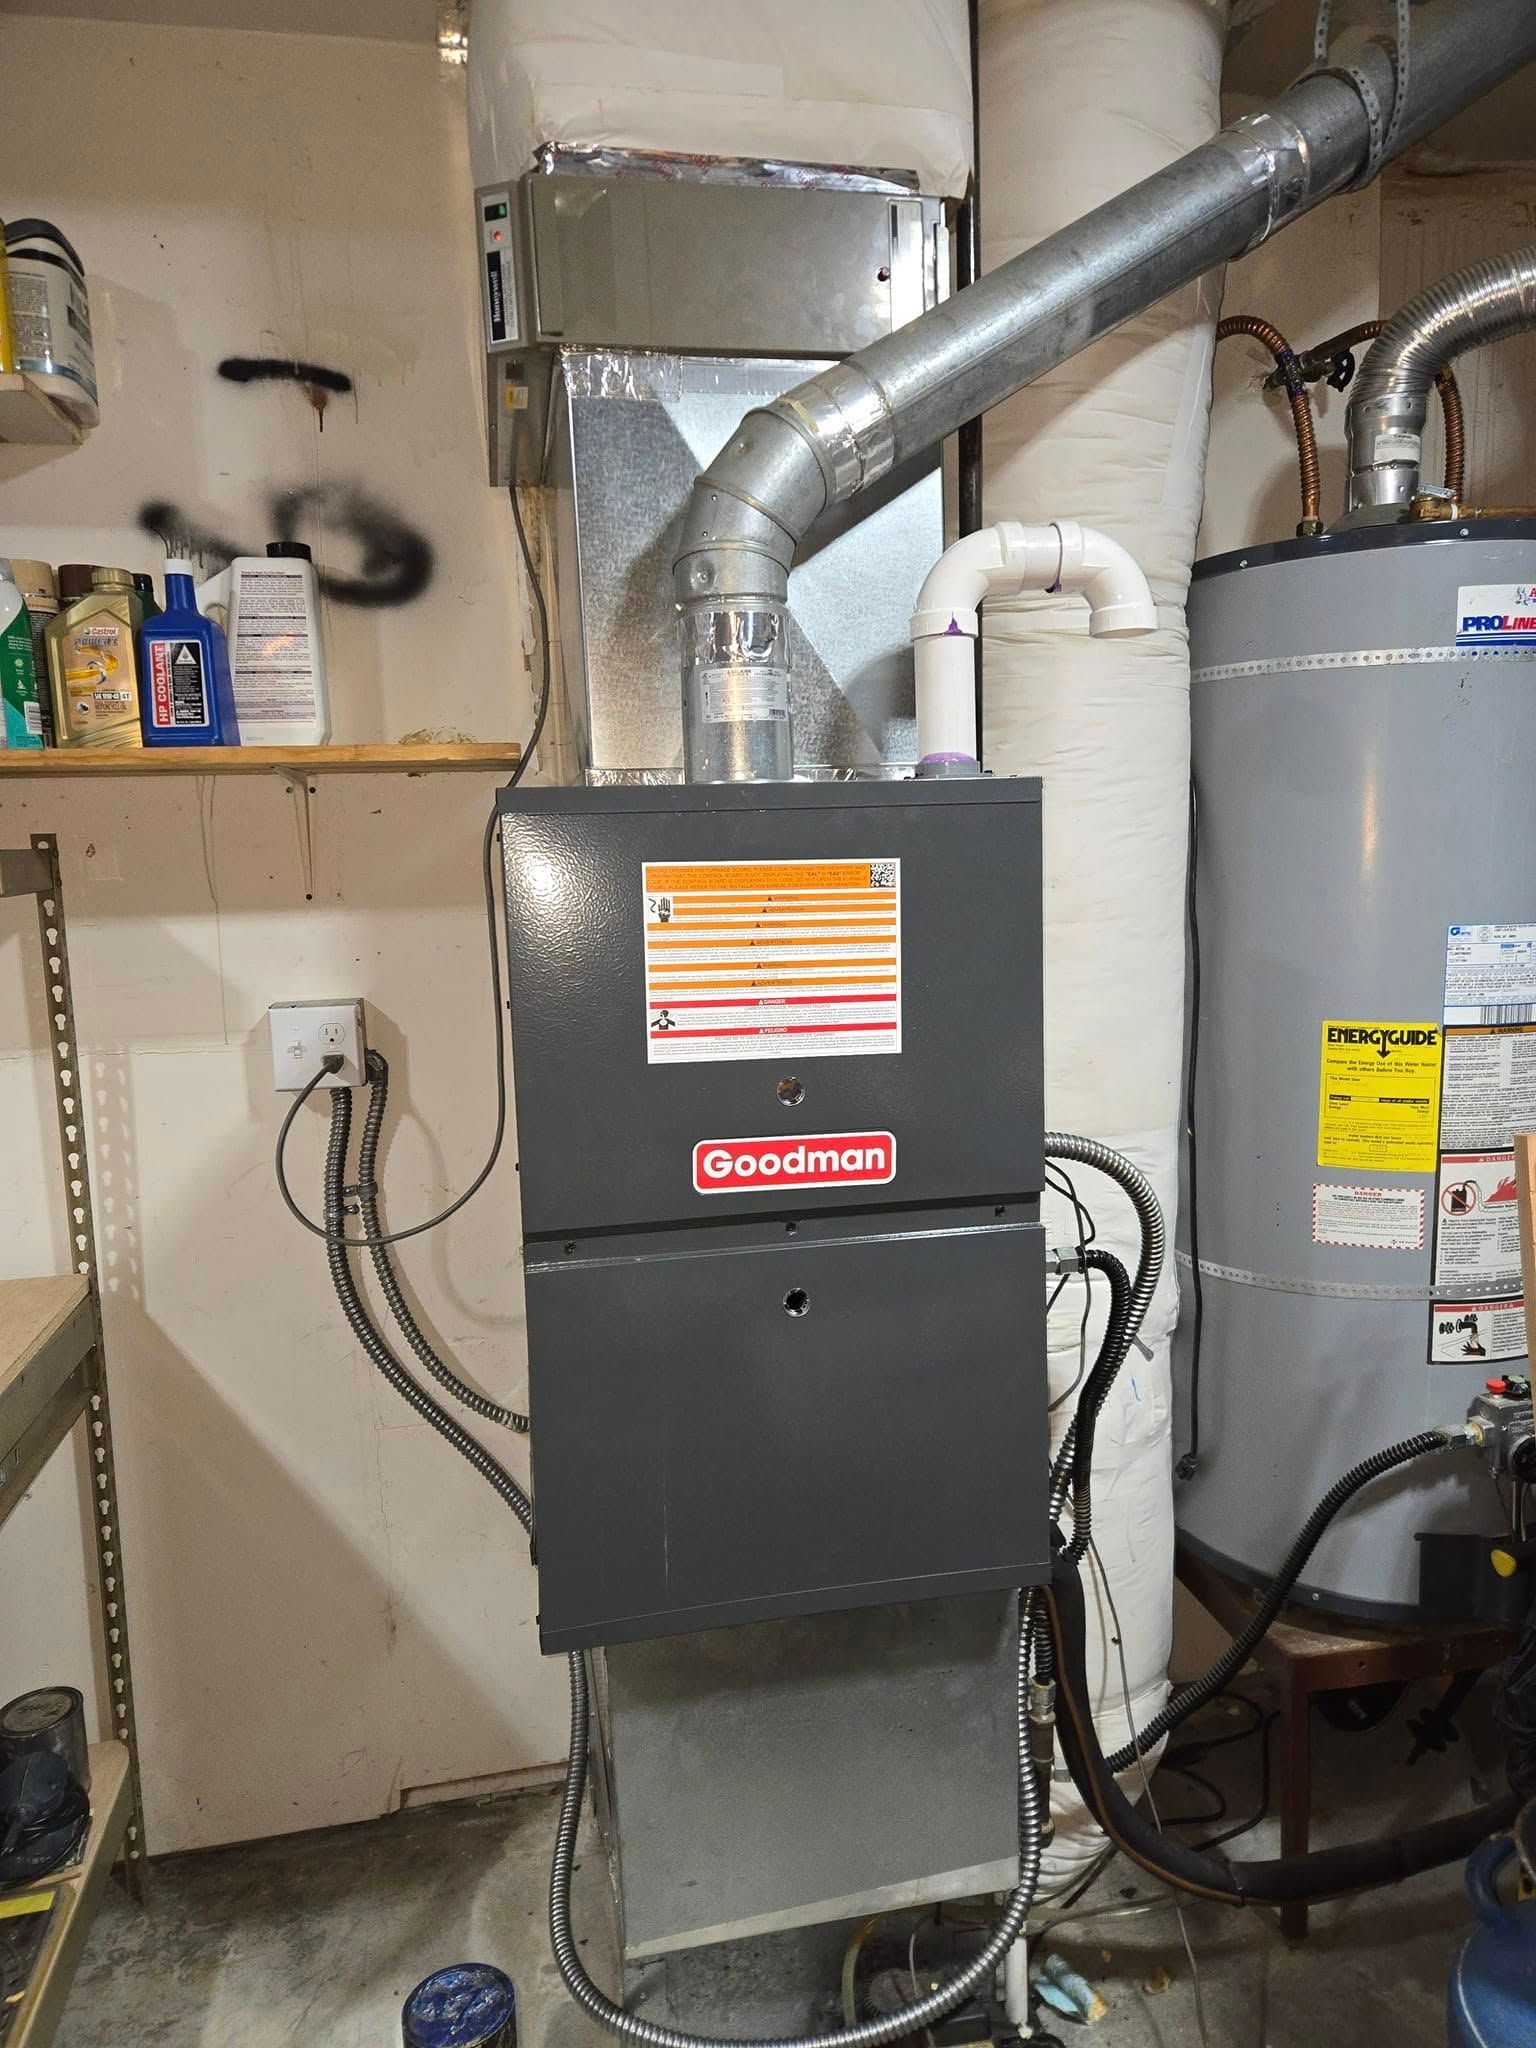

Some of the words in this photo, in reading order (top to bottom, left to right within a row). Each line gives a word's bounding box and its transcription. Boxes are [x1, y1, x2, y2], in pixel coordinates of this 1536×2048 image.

[490, 271, 501, 322] Honeywell
[91, 627, 116, 635] Castrol
[1463, 615, 1536, 632] PROLINE
[154, 645, 167, 703] COOLANT
[158, 705, 169, 722] HP
[1327, 1028, 1438, 1046] ENERGYGUIDE
[703, 1145, 885, 1179] Goodman
